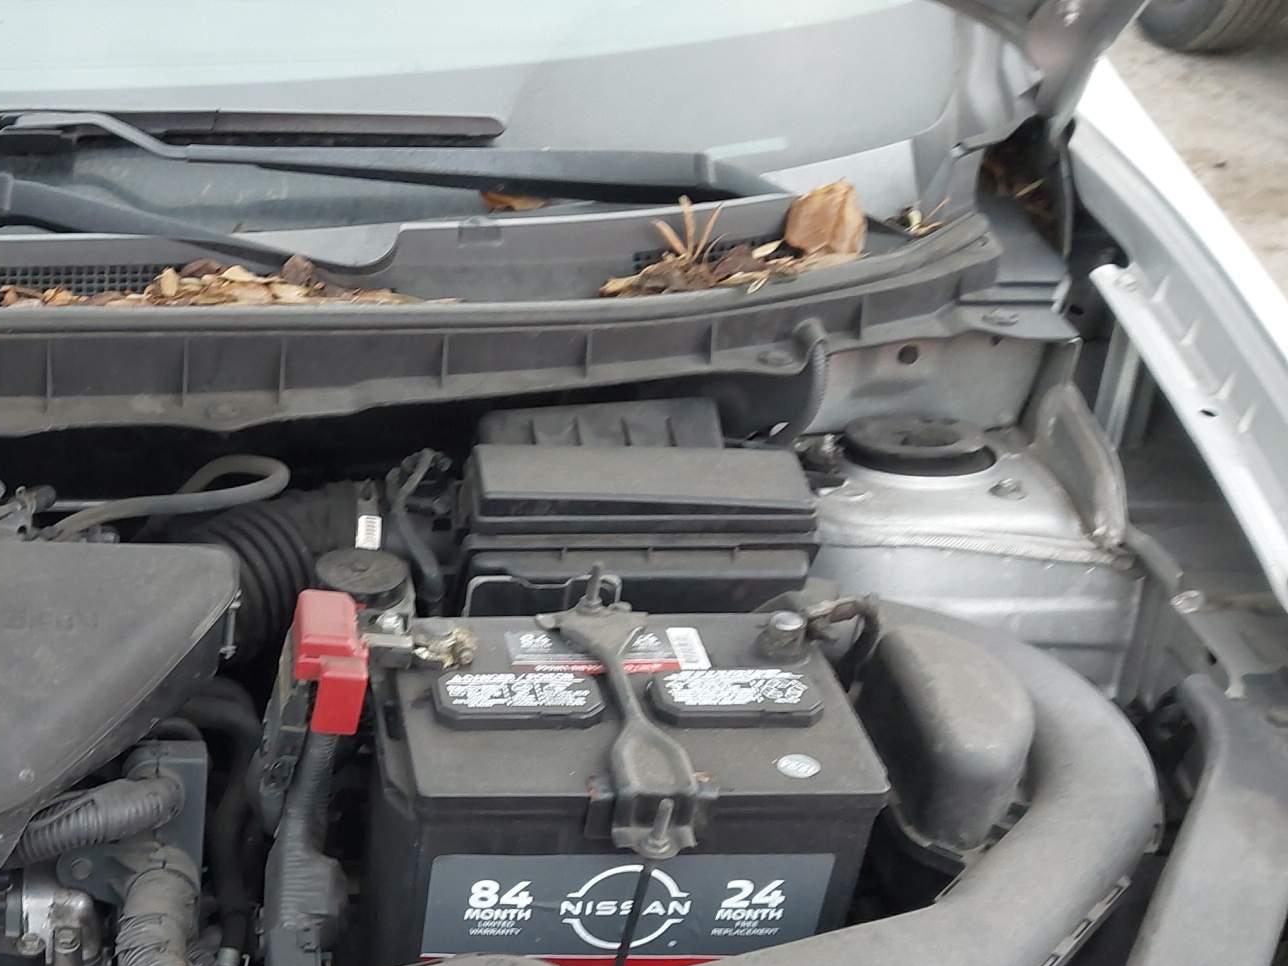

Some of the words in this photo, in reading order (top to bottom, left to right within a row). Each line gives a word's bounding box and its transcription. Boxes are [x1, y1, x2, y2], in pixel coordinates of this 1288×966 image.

[469, 880, 533, 908] 84
[721, 880, 785, 908] 24
[464, 909, 532, 920] MONTH
[560, 900, 692, 916] NISSAN
[715, 909, 784, 920] MONTH
